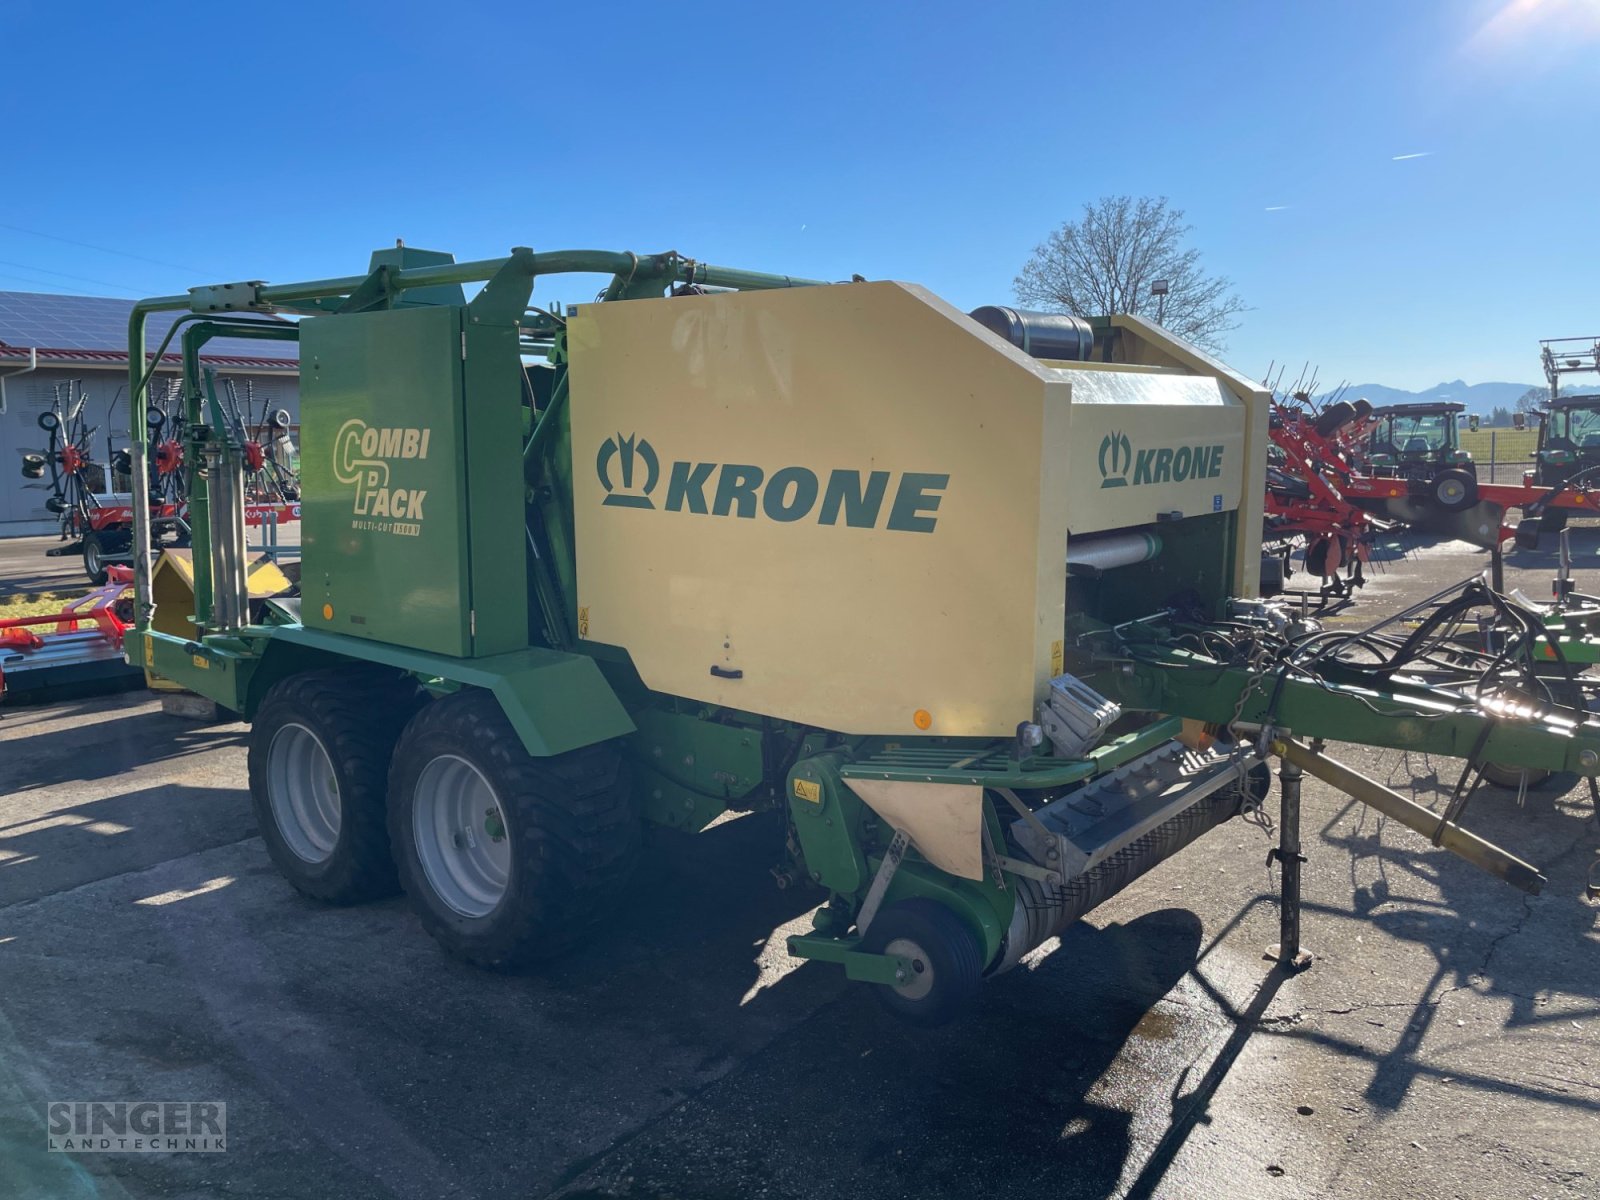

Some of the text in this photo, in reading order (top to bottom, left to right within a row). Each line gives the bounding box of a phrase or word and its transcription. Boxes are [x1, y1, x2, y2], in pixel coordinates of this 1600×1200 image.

[333, 419, 431, 484] COMBI
[1132, 445, 1225, 486] KRONE
[353, 460, 428, 520] PACK
[664, 461, 951, 534] KRONE
[352, 520, 393, 533] MULTI-CUT
